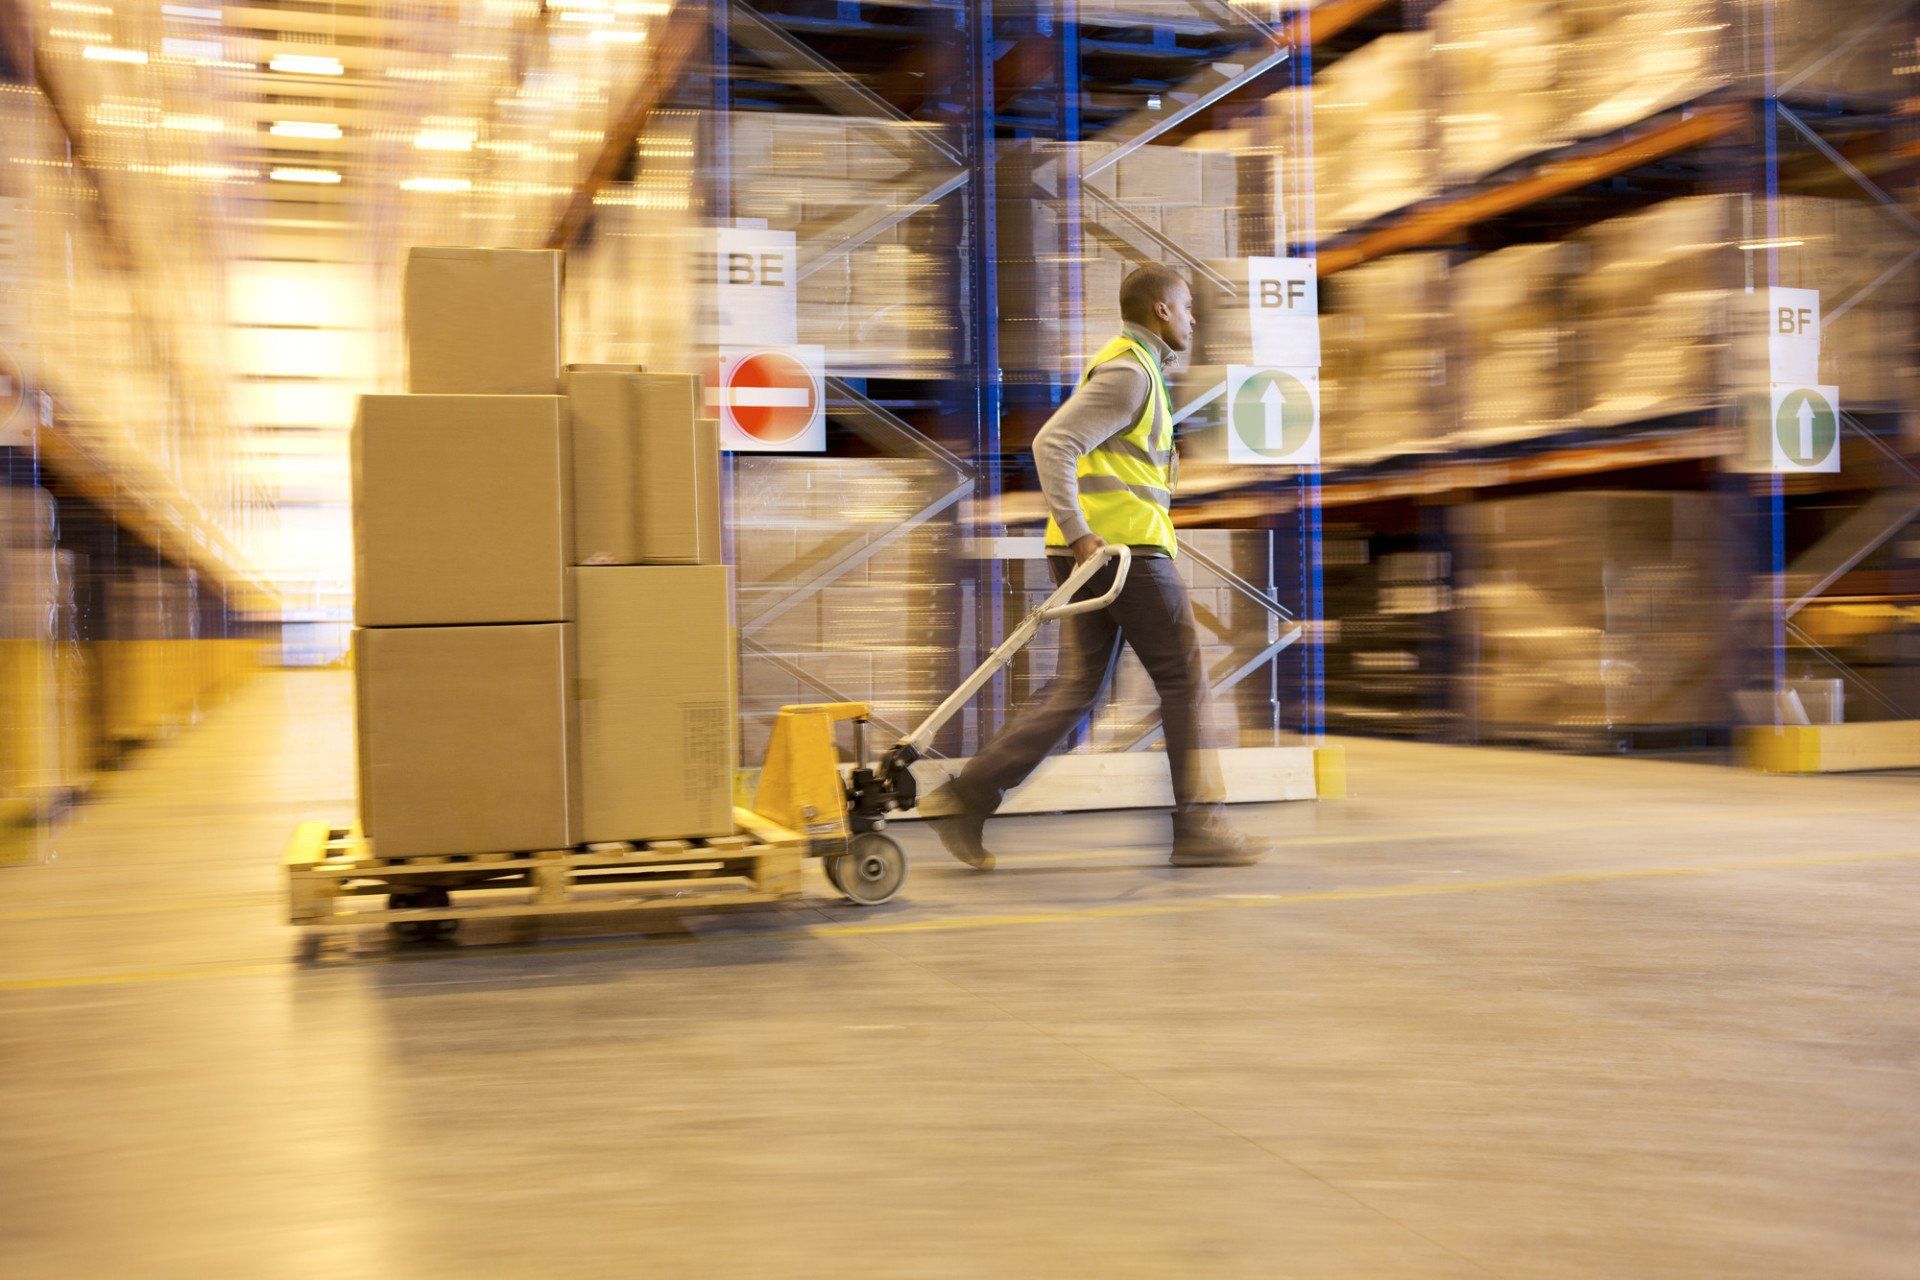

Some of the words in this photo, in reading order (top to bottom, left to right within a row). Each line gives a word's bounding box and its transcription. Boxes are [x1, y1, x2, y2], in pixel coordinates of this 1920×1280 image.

[729, 253, 784, 286] BE
[1260, 280, 1306, 309] BF
[1778, 306, 1812, 334] BF
